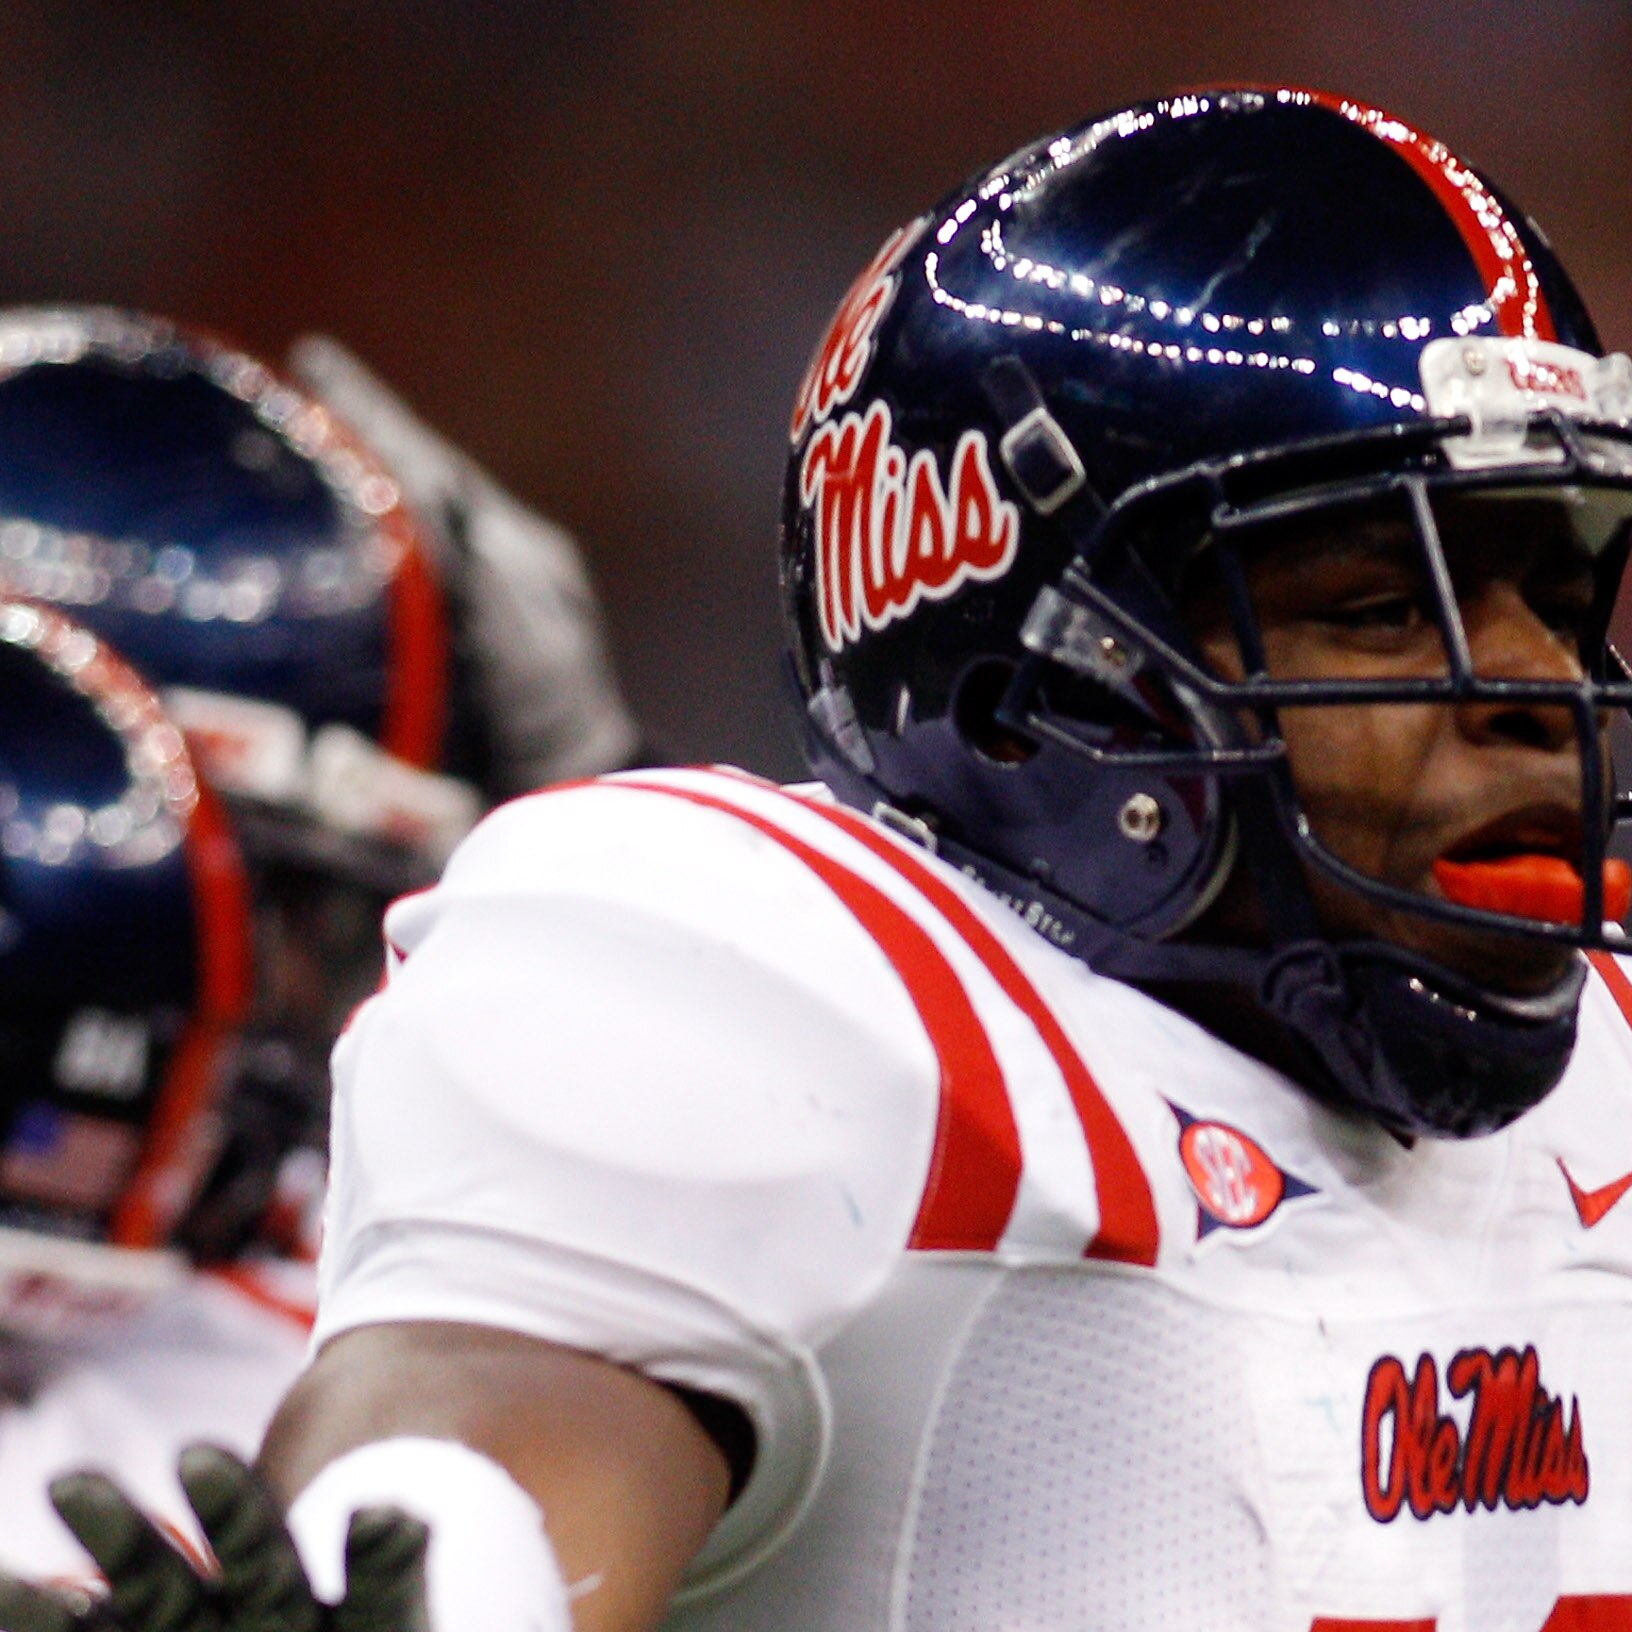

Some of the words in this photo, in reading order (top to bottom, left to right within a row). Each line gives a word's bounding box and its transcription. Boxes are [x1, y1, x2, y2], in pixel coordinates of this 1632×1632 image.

[800, 398, 1020, 653] Miss
[1193, 1125, 1258, 1224] SEC
[1361, 1351, 1461, 1524] Ole
[1446, 1341, 1590, 1515] Miss
